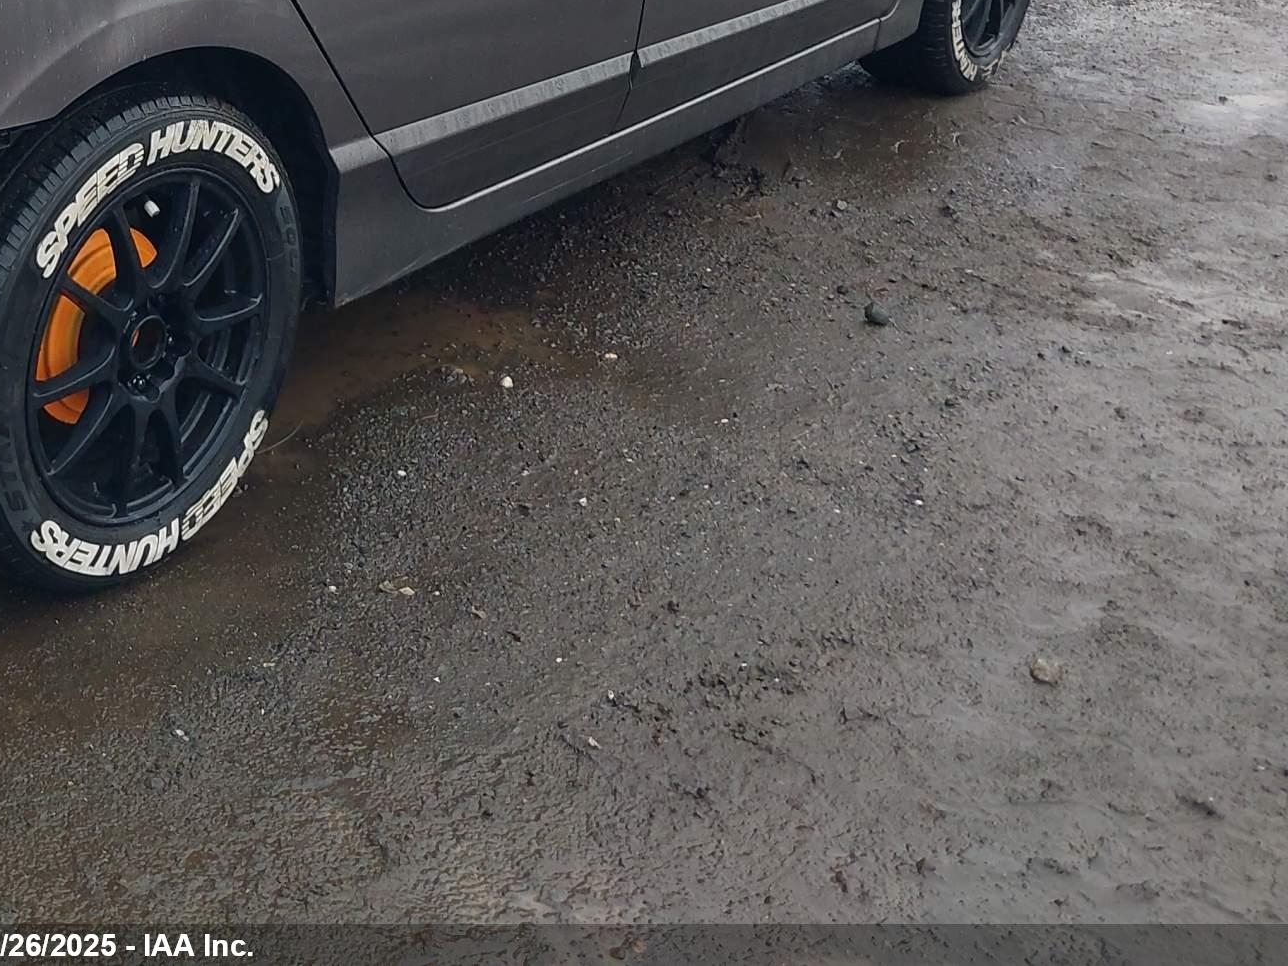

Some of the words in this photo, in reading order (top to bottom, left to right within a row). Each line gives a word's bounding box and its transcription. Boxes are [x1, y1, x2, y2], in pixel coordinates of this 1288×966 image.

[36, 142, 147, 279] SPEED
[147, 119, 281, 195] HUNTERS
[179, 408, 270, 542] SPEED
[30, 518, 180, 576] HUNTERS
